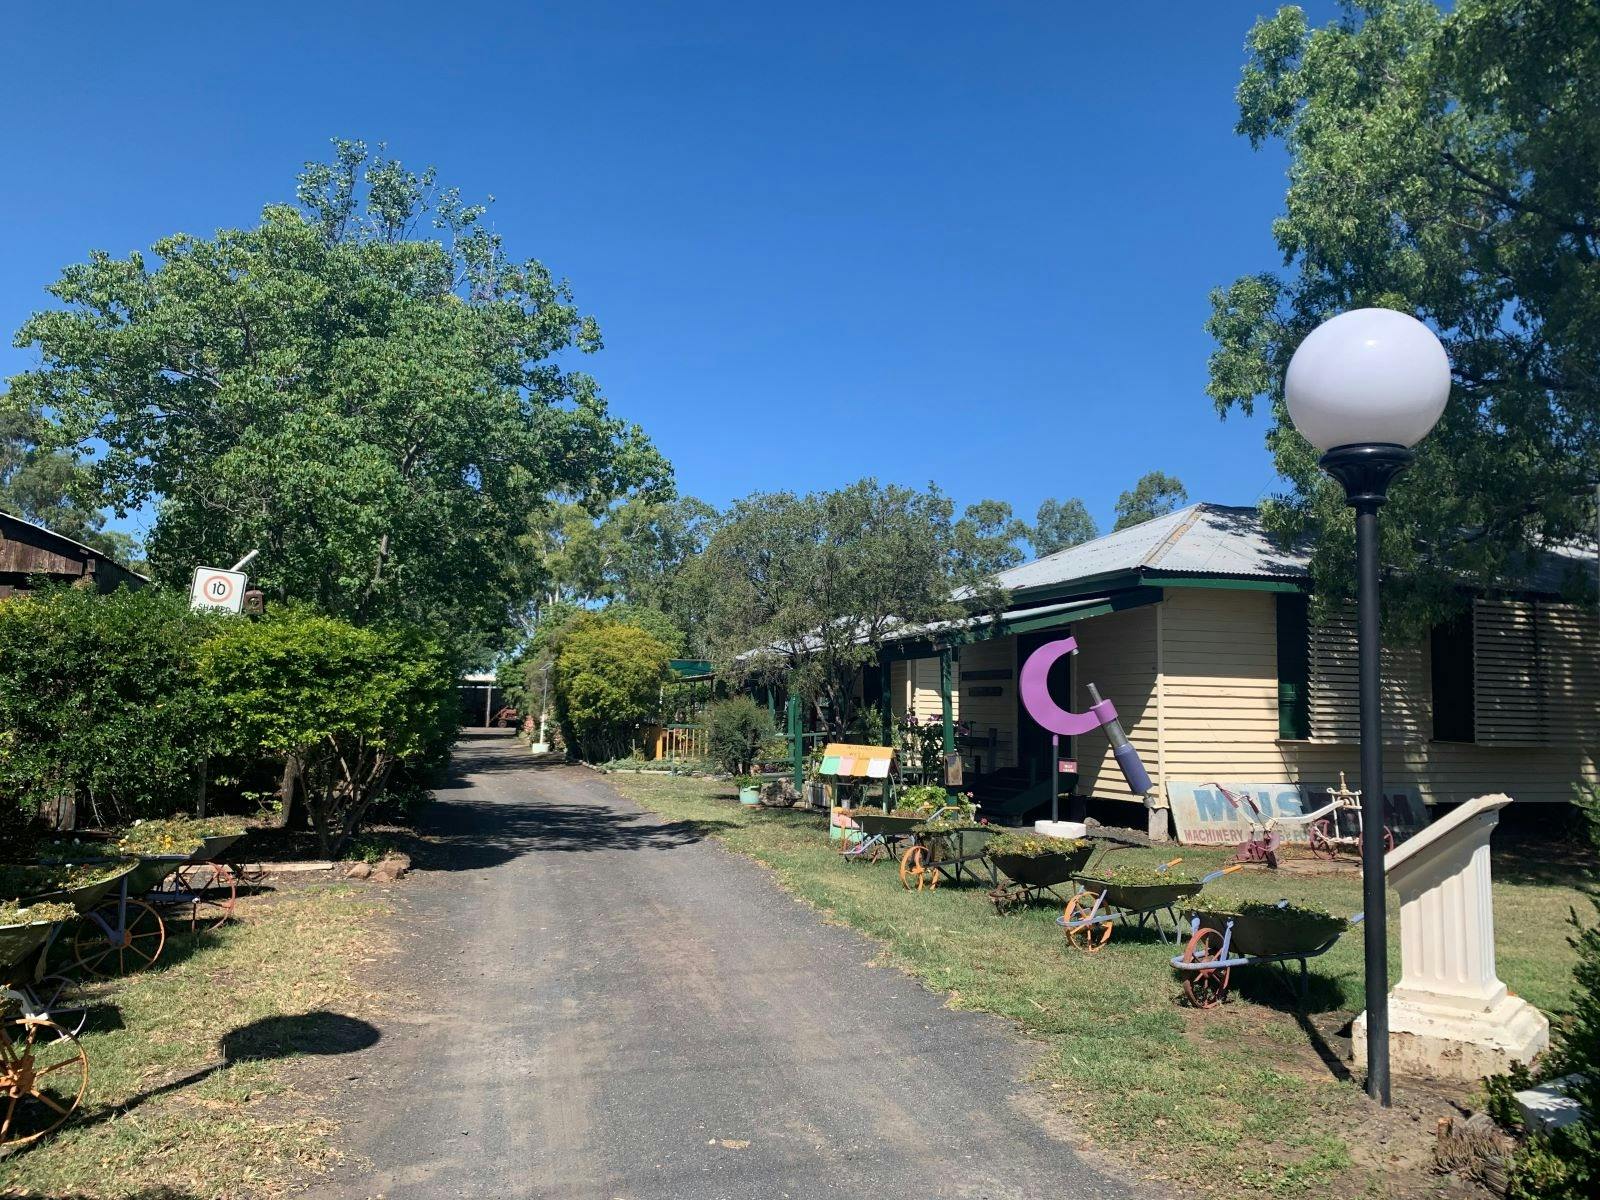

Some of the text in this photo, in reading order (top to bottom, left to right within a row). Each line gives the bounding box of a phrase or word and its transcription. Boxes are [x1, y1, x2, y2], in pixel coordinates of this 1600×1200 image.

[213, 582, 226, 595] 10
[1193, 789, 1414, 825] MUSM
[1184, 829, 1243, 842] MACHINERY
